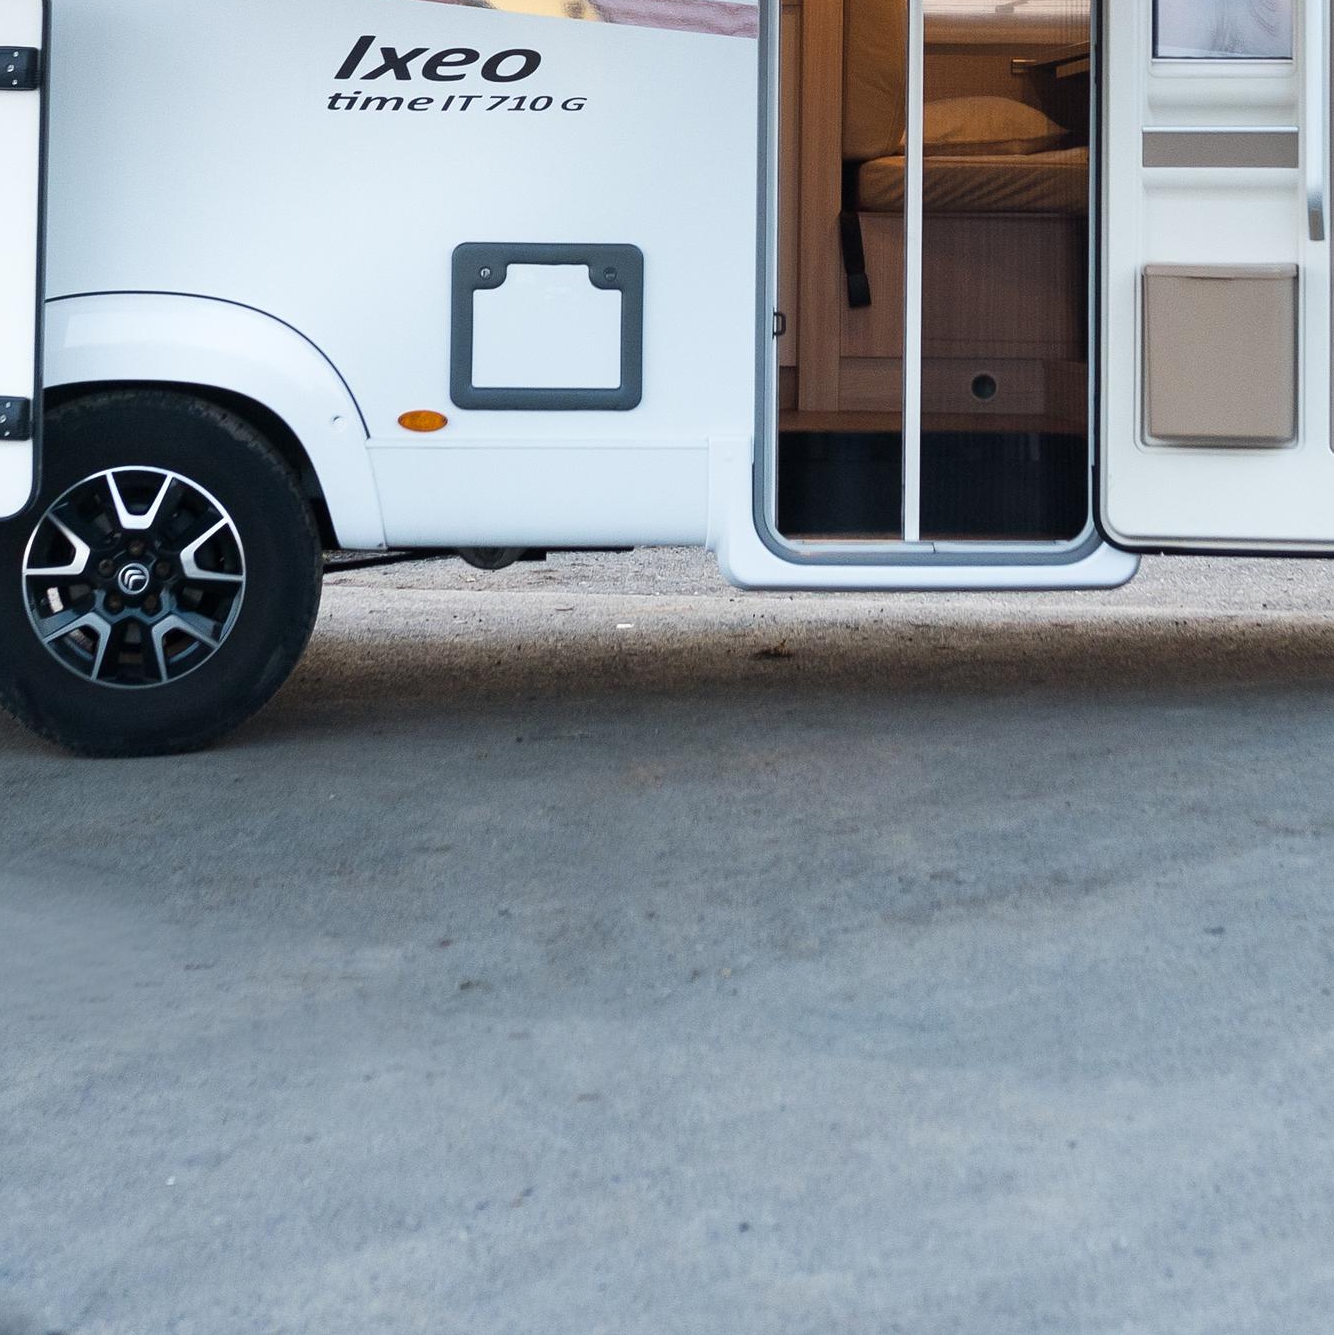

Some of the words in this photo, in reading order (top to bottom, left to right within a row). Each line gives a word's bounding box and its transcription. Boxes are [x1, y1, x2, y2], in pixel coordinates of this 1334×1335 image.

[333, 34, 542, 83] Ixeo
[326, 90, 434, 111] time
[440, 95, 483, 111] IT
[484, 95, 554, 111] 710
[560, 97, 588, 111] G
